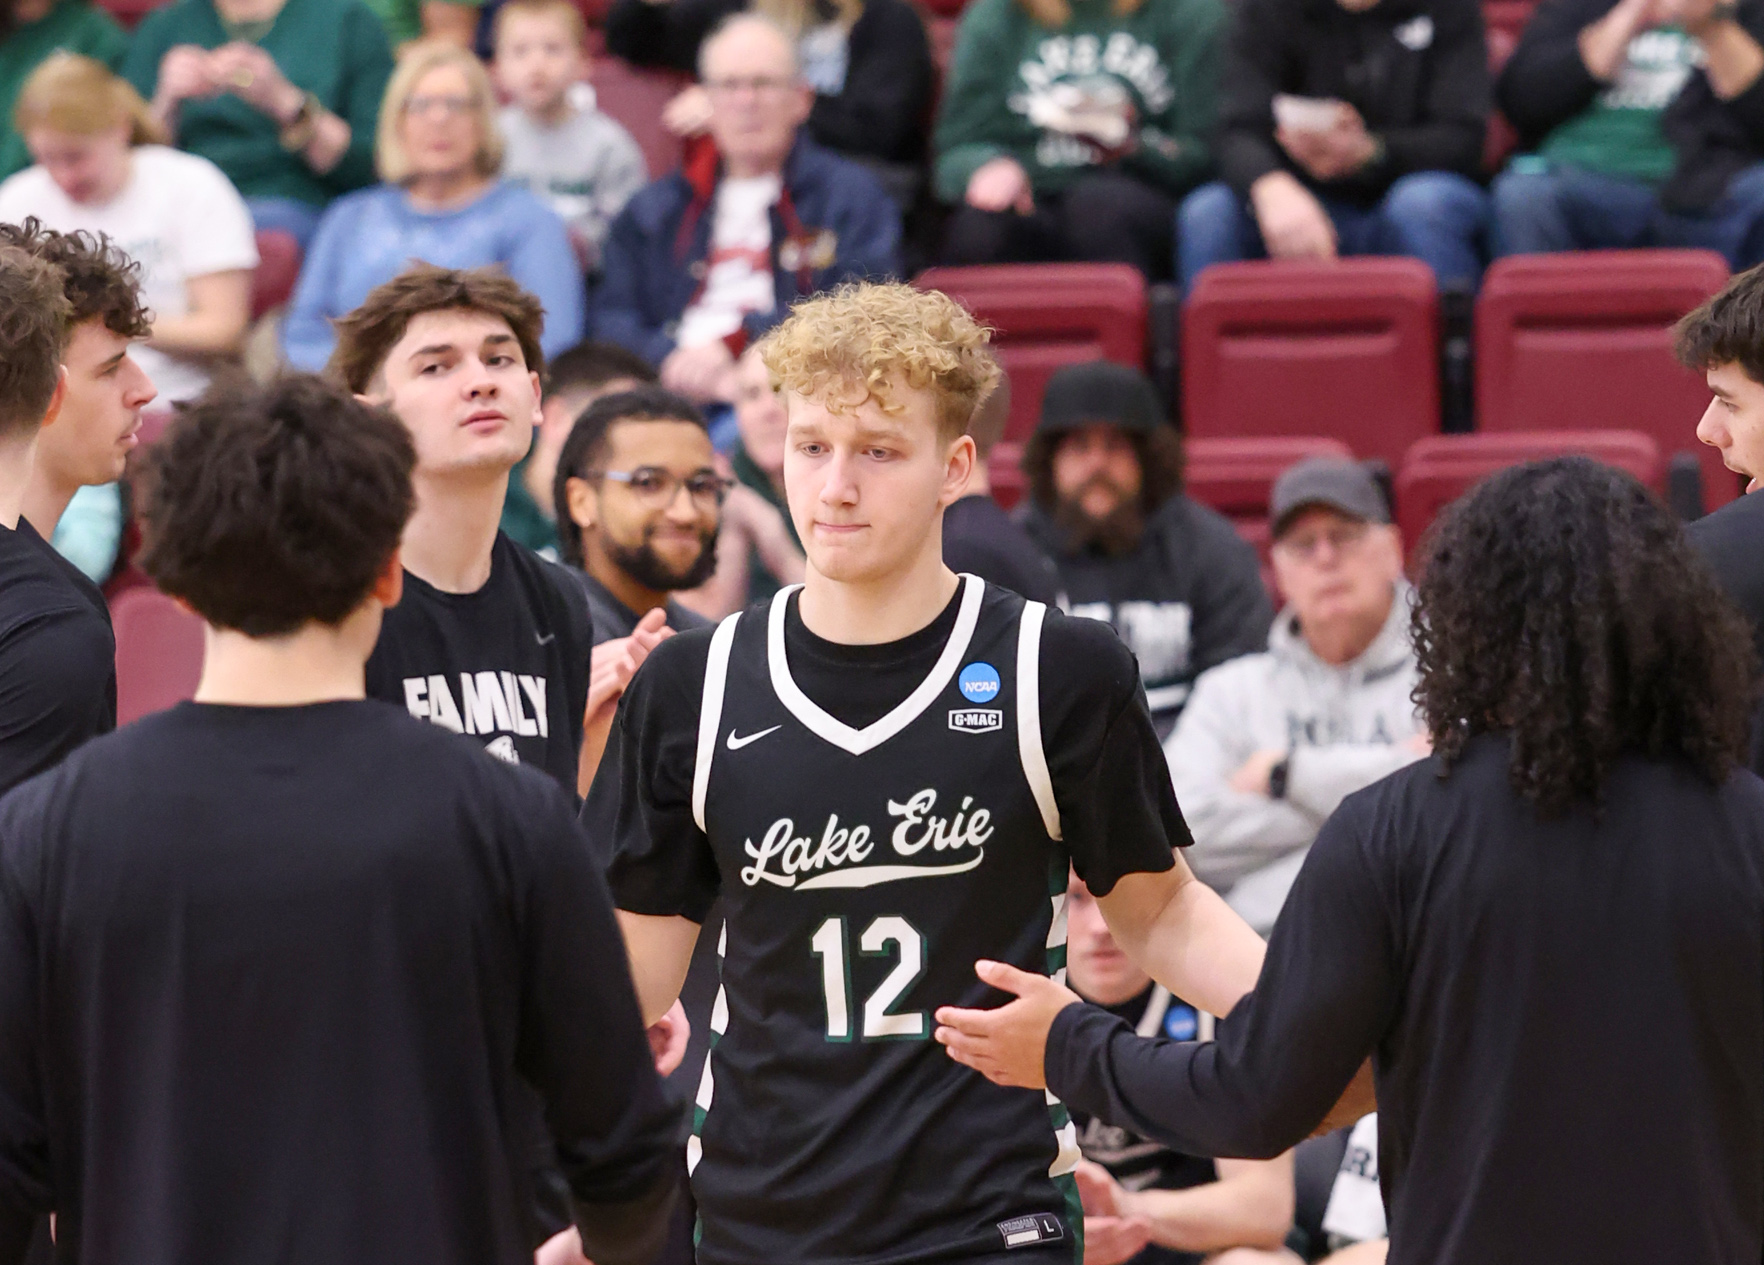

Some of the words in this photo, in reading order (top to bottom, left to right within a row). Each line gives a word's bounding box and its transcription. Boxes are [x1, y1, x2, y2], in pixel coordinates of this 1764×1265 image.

[403, 670, 549, 738] FAMILY
[964, 681, 998, 693] NCAA
[741, 813, 875, 888] Lake
[888, 788, 995, 856] Erie
[808, 914, 930, 1043] 12
[1043, 1219, 1055, 1233] L
